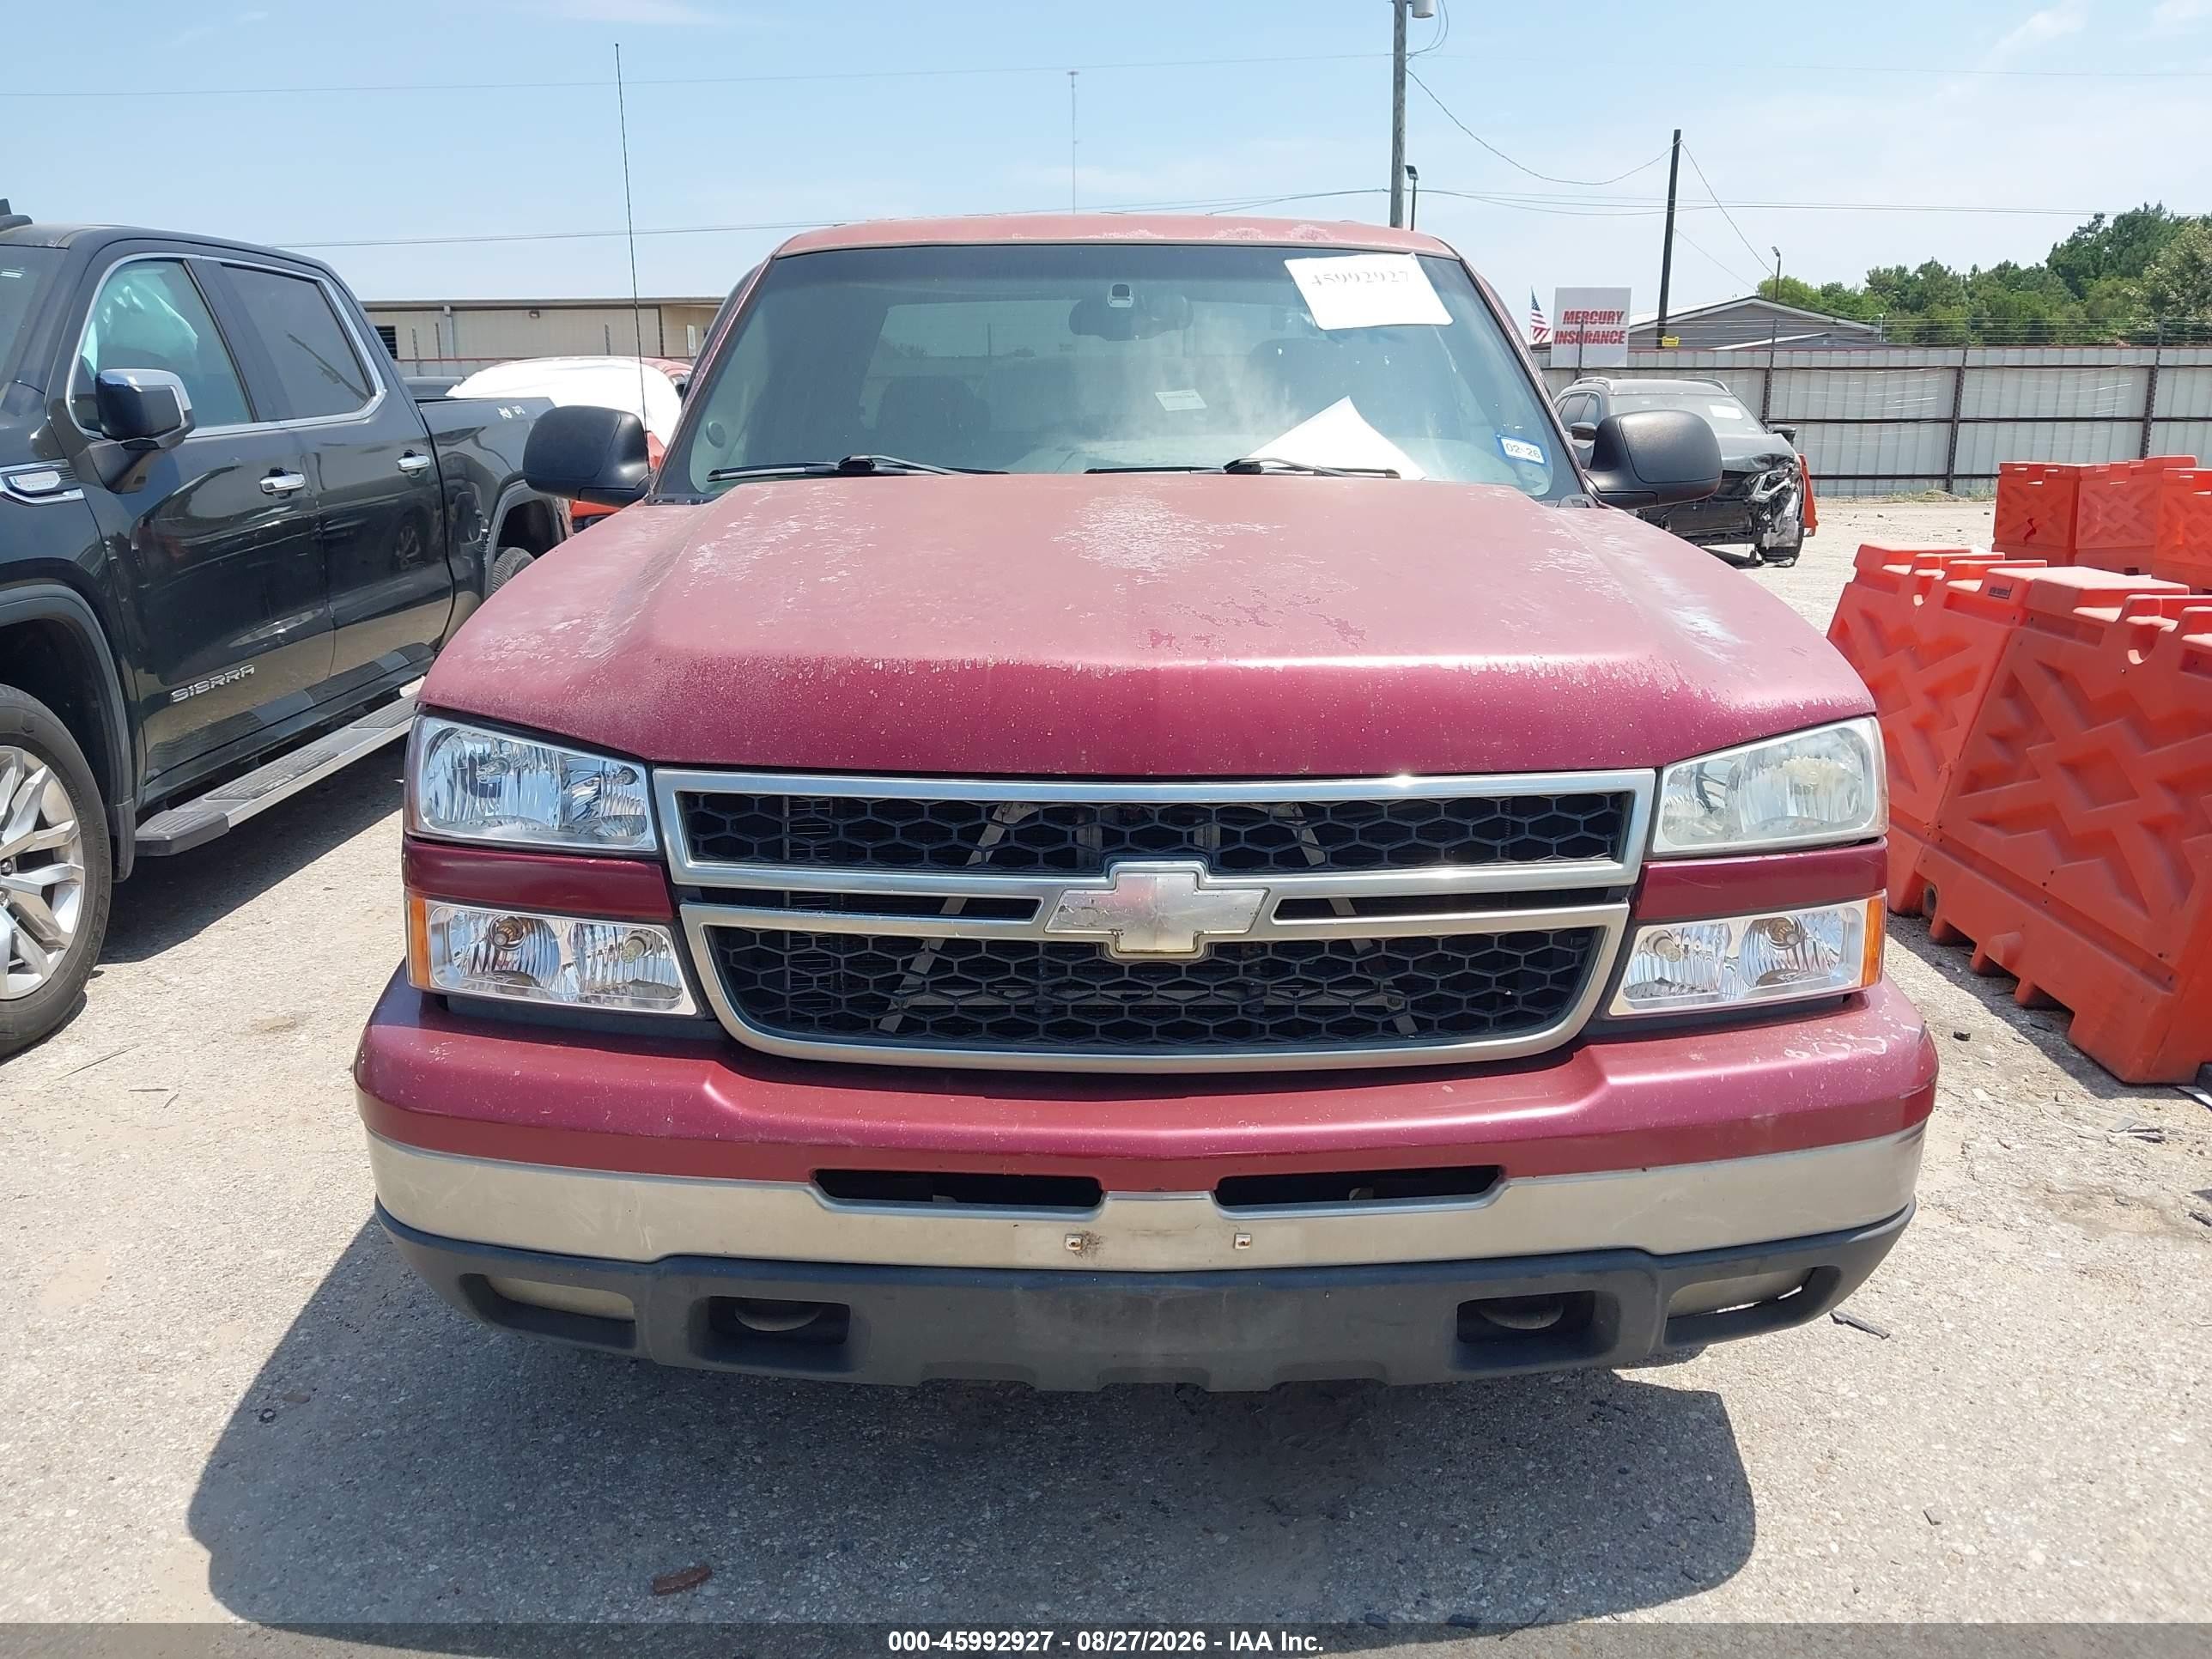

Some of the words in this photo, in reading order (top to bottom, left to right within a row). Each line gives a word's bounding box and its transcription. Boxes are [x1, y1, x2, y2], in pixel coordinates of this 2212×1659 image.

[1563, 310, 1625, 325] MERCURY
[1553, 330, 1626, 345] INSURANCE
[172, 664, 255, 702] SIERRA
